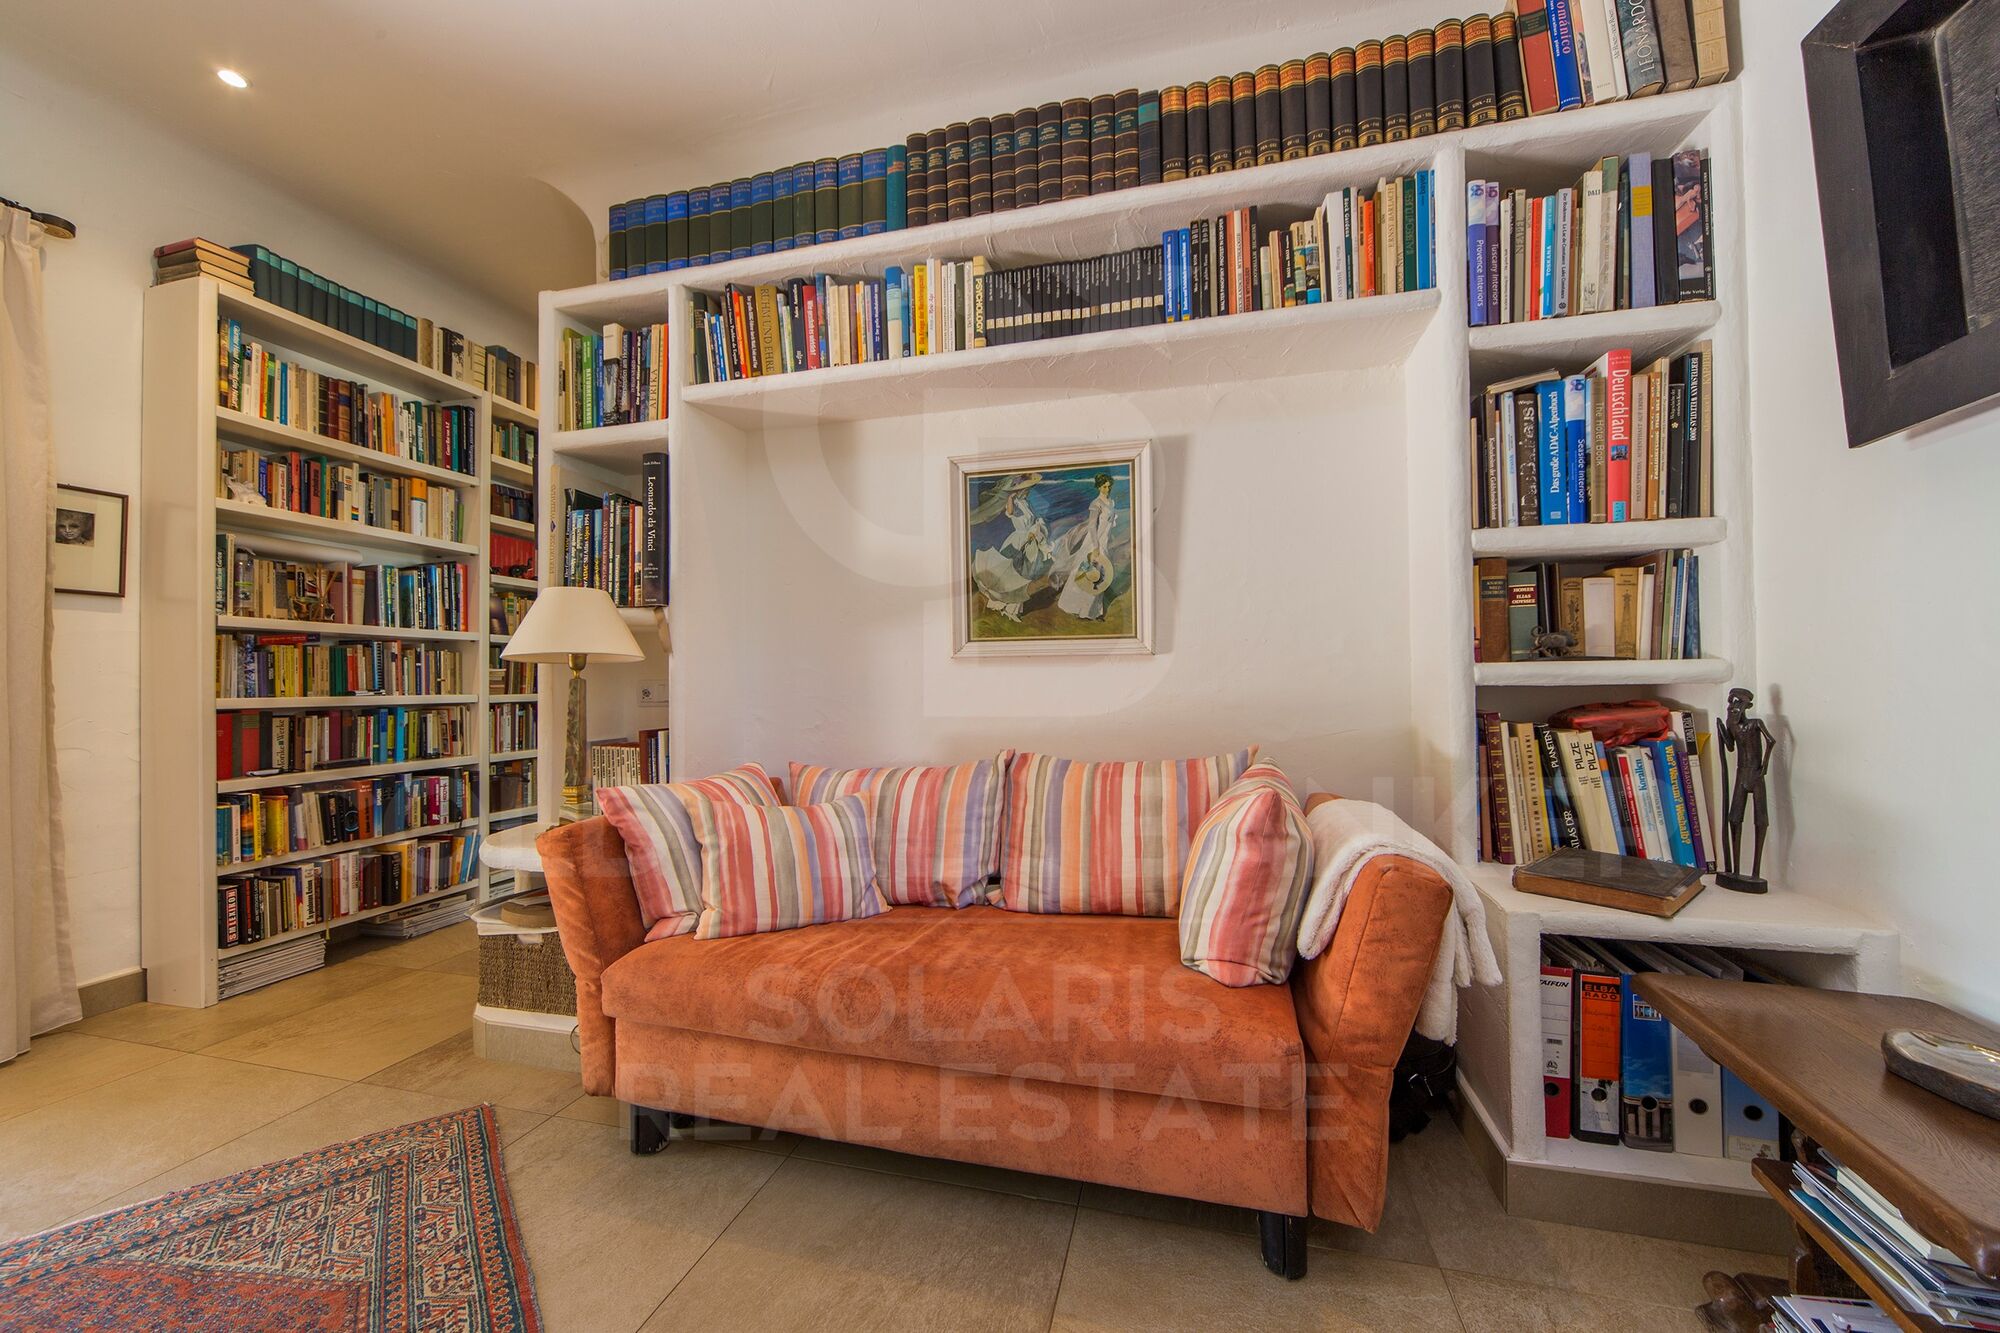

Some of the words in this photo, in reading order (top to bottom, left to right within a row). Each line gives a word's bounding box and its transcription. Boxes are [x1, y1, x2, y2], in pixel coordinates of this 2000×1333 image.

[1387, 223, 1395, 248] ERNST
[1514, 218, 1524, 255] NEAPEL
[1476, 240, 1484, 274] Provence
[1490, 243, 1498, 272] Tuscany
[760, 288, 770, 319] RUHM
[1477, 275, 1485, 307] Interiors
[1491, 273, 1499, 305] Interiors
[975, 278, 984, 334] PSYCHOLOGY
[762, 320, 772, 344] UND
[764, 346, 775, 372] EHRE
[649, 368, 657, 409] AFRIKA
[1690, 357, 1699, 396] BERTELSMANN
[1595, 401, 1604, 417] The
[1612, 369, 1629, 441] Deutschland
[1549, 391, 1559, 456] ADAC-Alpenbuch
[1595, 419, 1604, 442] Hotel
[1689, 426, 1698, 441] 2000
[1550, 456, 1562, 478] große
[1577, 438, 1585, 468] Seaside
[1595, 444, 1604, 466] Book
[646, 476, 656, 516] Leonardo
[1550, 477, 1560, 493] Das
[1577, 470, 1585, 503] Interiors
[647, 518, 656, 529] da
[646, 529, 656, 552] Vinci
[277, 719, 285, 741] Werke
[1543, 730, 1560, 768] PLANETEN
[1570, 741, 1585, 770] PILZE
[1583, 742, 1598, 771] PILZE
[1664, 744, 1677, 766] Wie?
[1634, 758, 1648, 791] Korallen
[1668, 767, 1684, 802] Warum?
[1683, 756, 1694, 794] PROVENCE
[1563, 810, 1577, 826] DER
[1676, 803, 1691, 845] Weshalb?
[1691, 816, 1700, 836] Leben
[1567, 827, 1581, 849] ATLAS
[1583, 984, 1616, 994] ELBA
